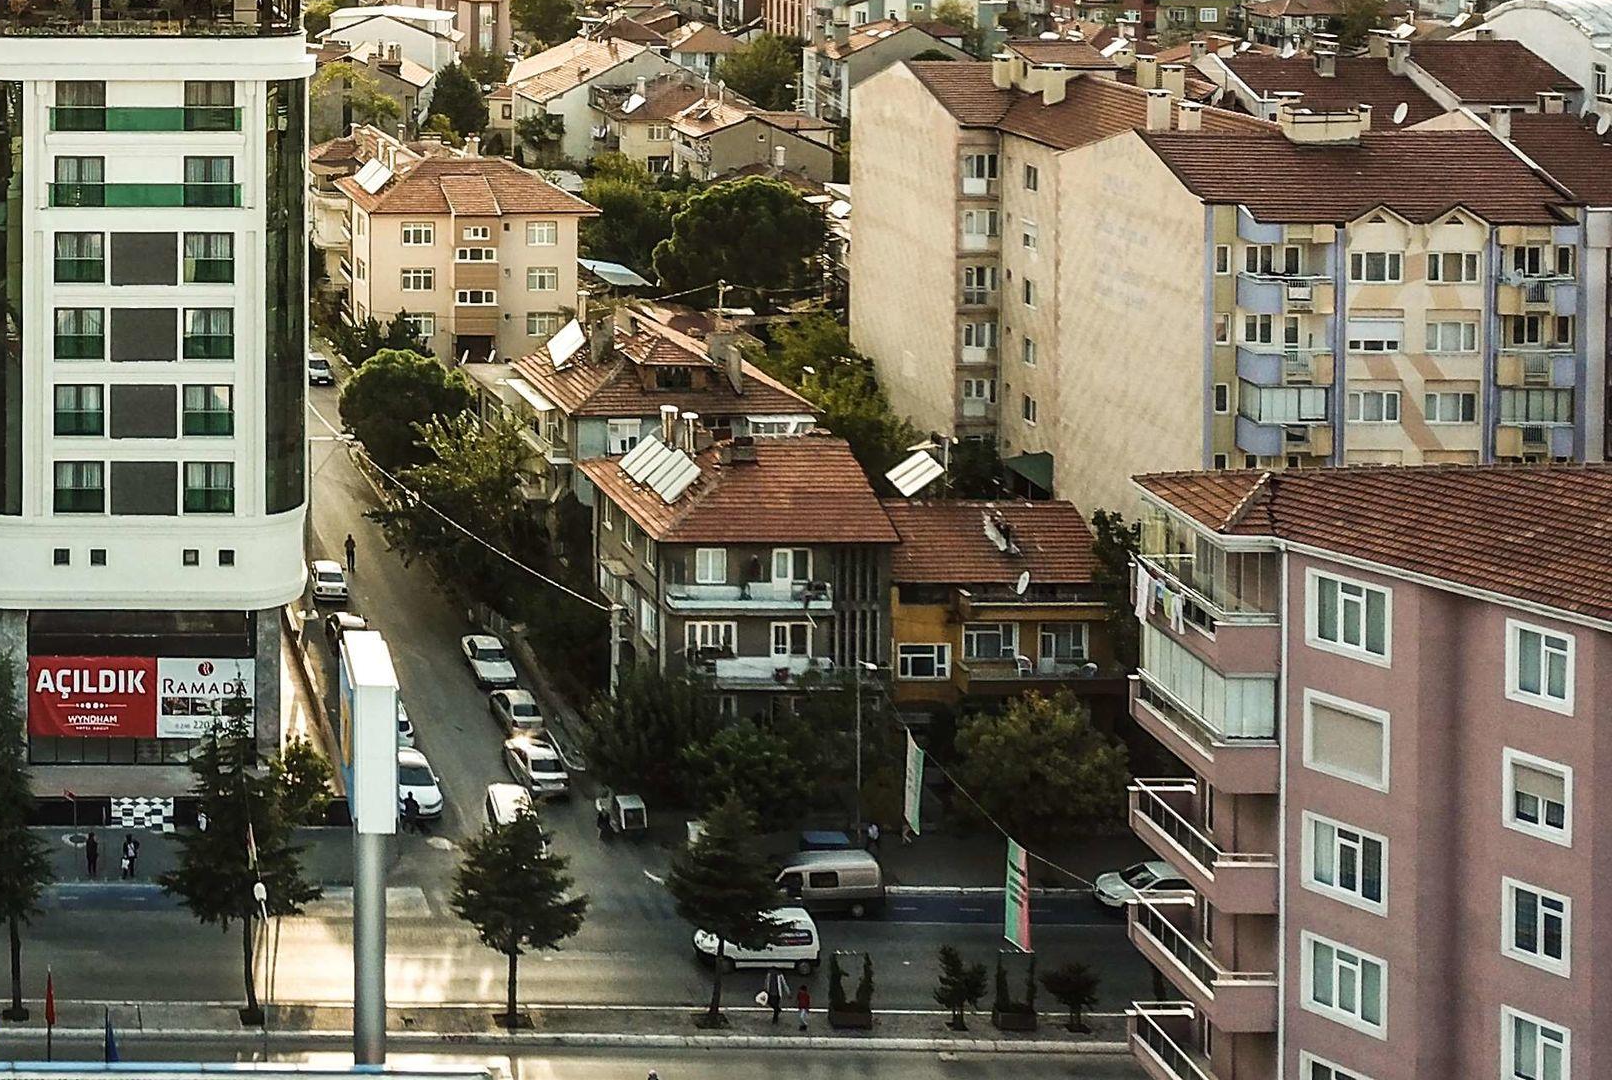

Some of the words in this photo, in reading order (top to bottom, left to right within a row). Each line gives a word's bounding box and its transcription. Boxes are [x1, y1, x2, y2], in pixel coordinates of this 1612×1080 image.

[35, 668, 146, 698] AÇILDIK
[163, 678, 247, 695] RAMADA
[67, 715, 118, 723] WYNDHAM
